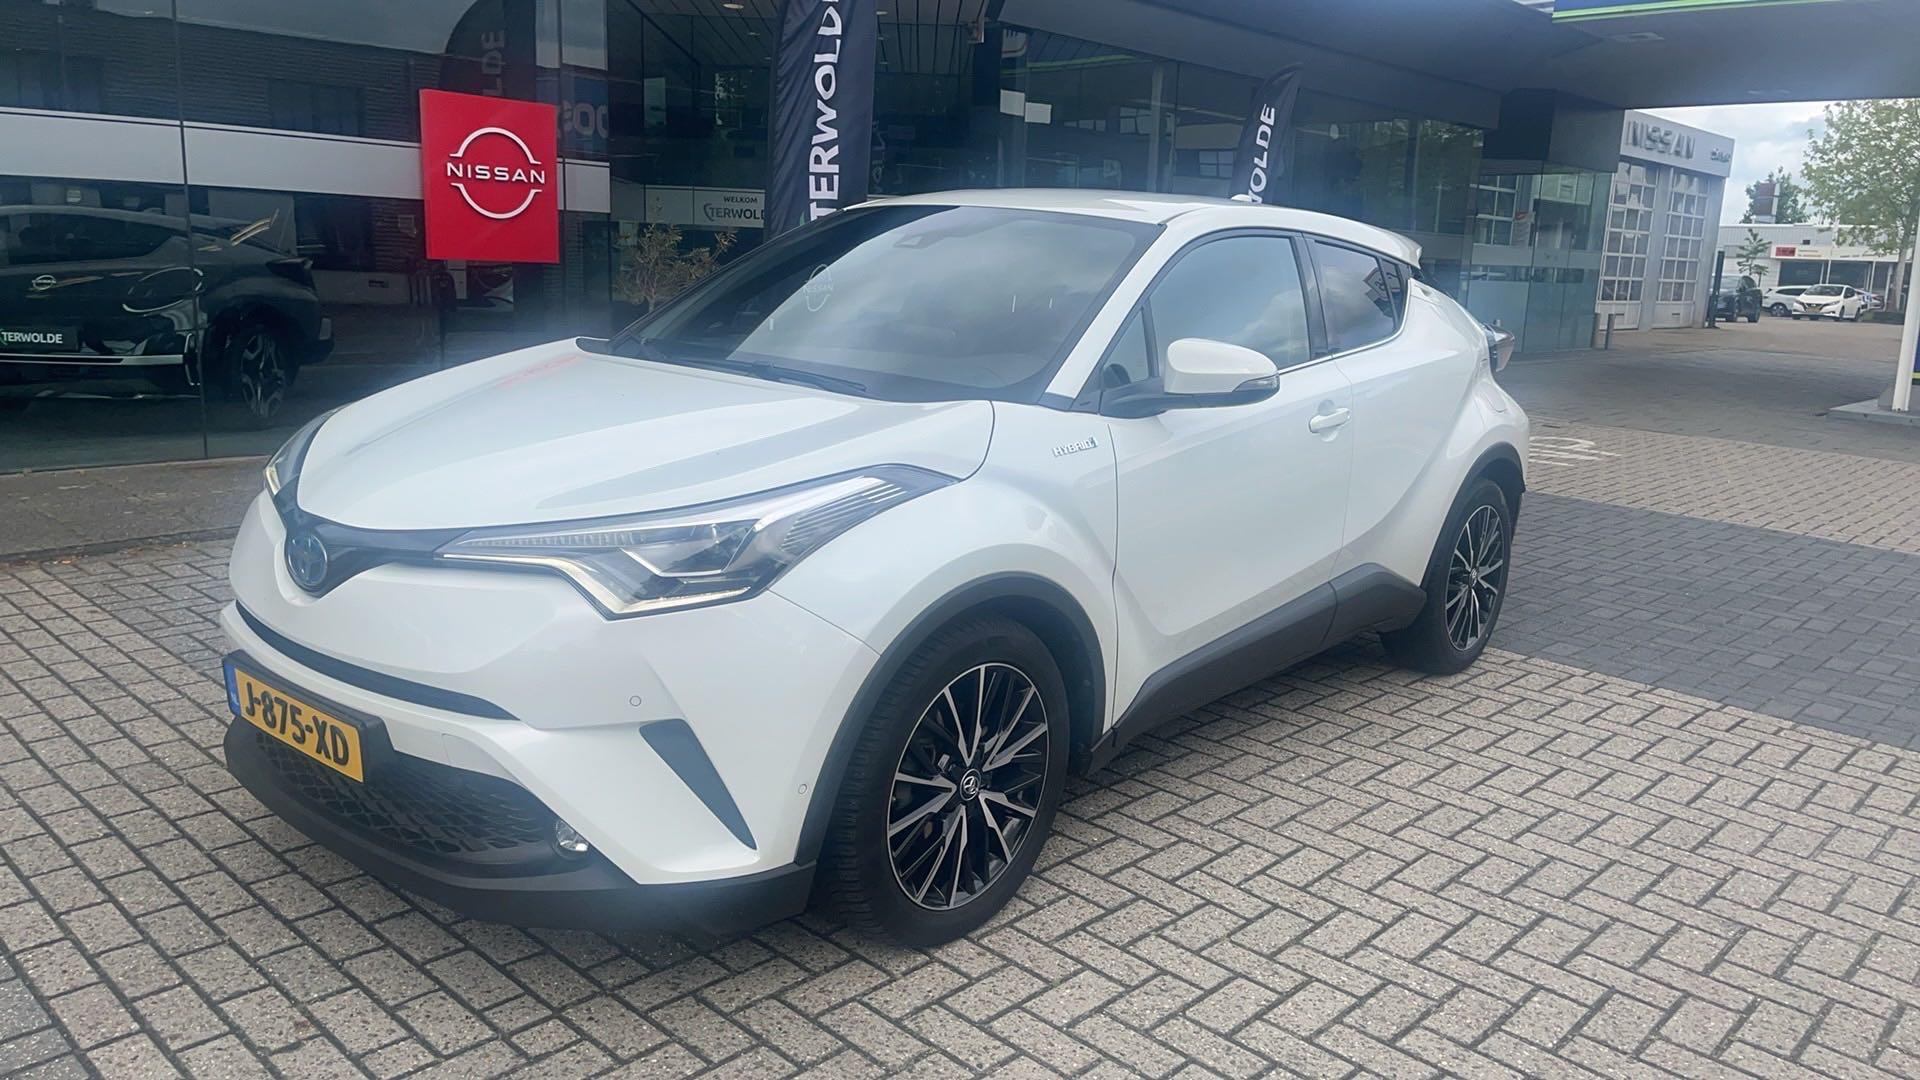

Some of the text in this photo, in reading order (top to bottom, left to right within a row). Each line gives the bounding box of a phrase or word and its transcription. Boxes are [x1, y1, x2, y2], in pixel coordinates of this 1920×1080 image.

[808, 0, 842, 221] TERWOLD
[1625, 120, 1696, 160] NISSAN
[447, 162, 545, 184] NISSAN
[723, 196, 758, 204] WELKOM
[2, 332, 63, 344] TERWOLDE
[1052, 438, 1092, 457] HYBRID
[245, 681, 350, 766] J-875-XD
